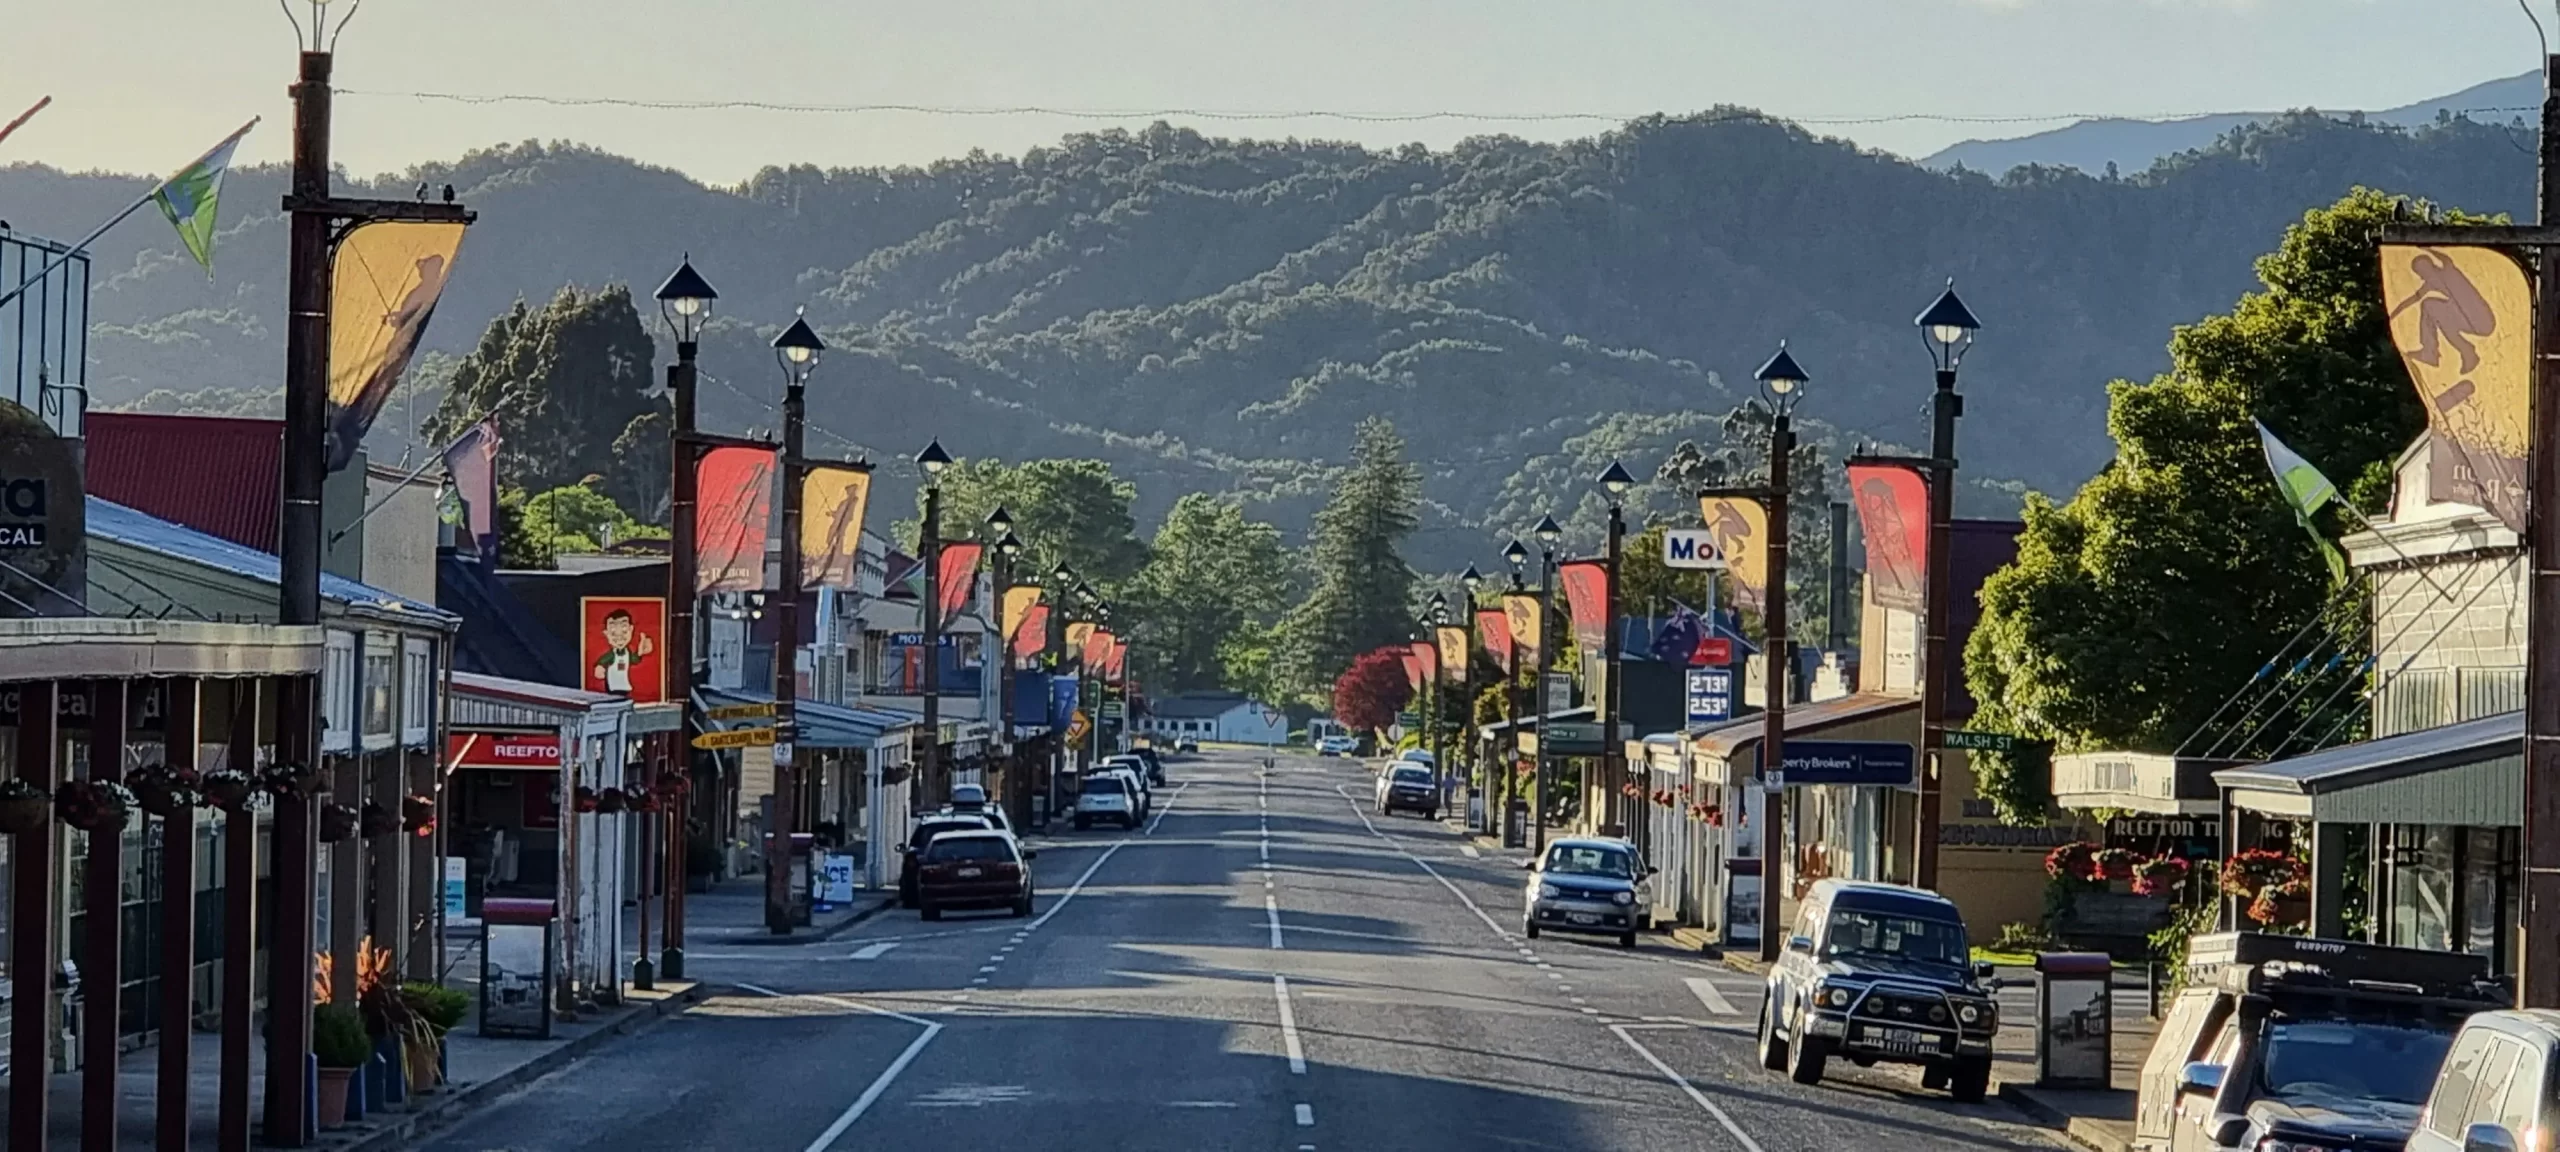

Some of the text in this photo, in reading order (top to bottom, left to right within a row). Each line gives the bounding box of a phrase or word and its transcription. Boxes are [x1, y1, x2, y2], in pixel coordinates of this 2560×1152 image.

[0, 527, 42, 545] CAL
[1670, 537, 1724, 560] Mo
[898, 634, 946, 645] MOTS
[1945, 733, 2012, 750] WALSH ST
[494, 745, 559, 758] REEFTO
[1782, 757, 1811, 770] perty
[1811, 756, 1851, 769] Brokers
[2113, 818, 2194, 838] REEFTON
[825, 866, 849, 884] ICE
